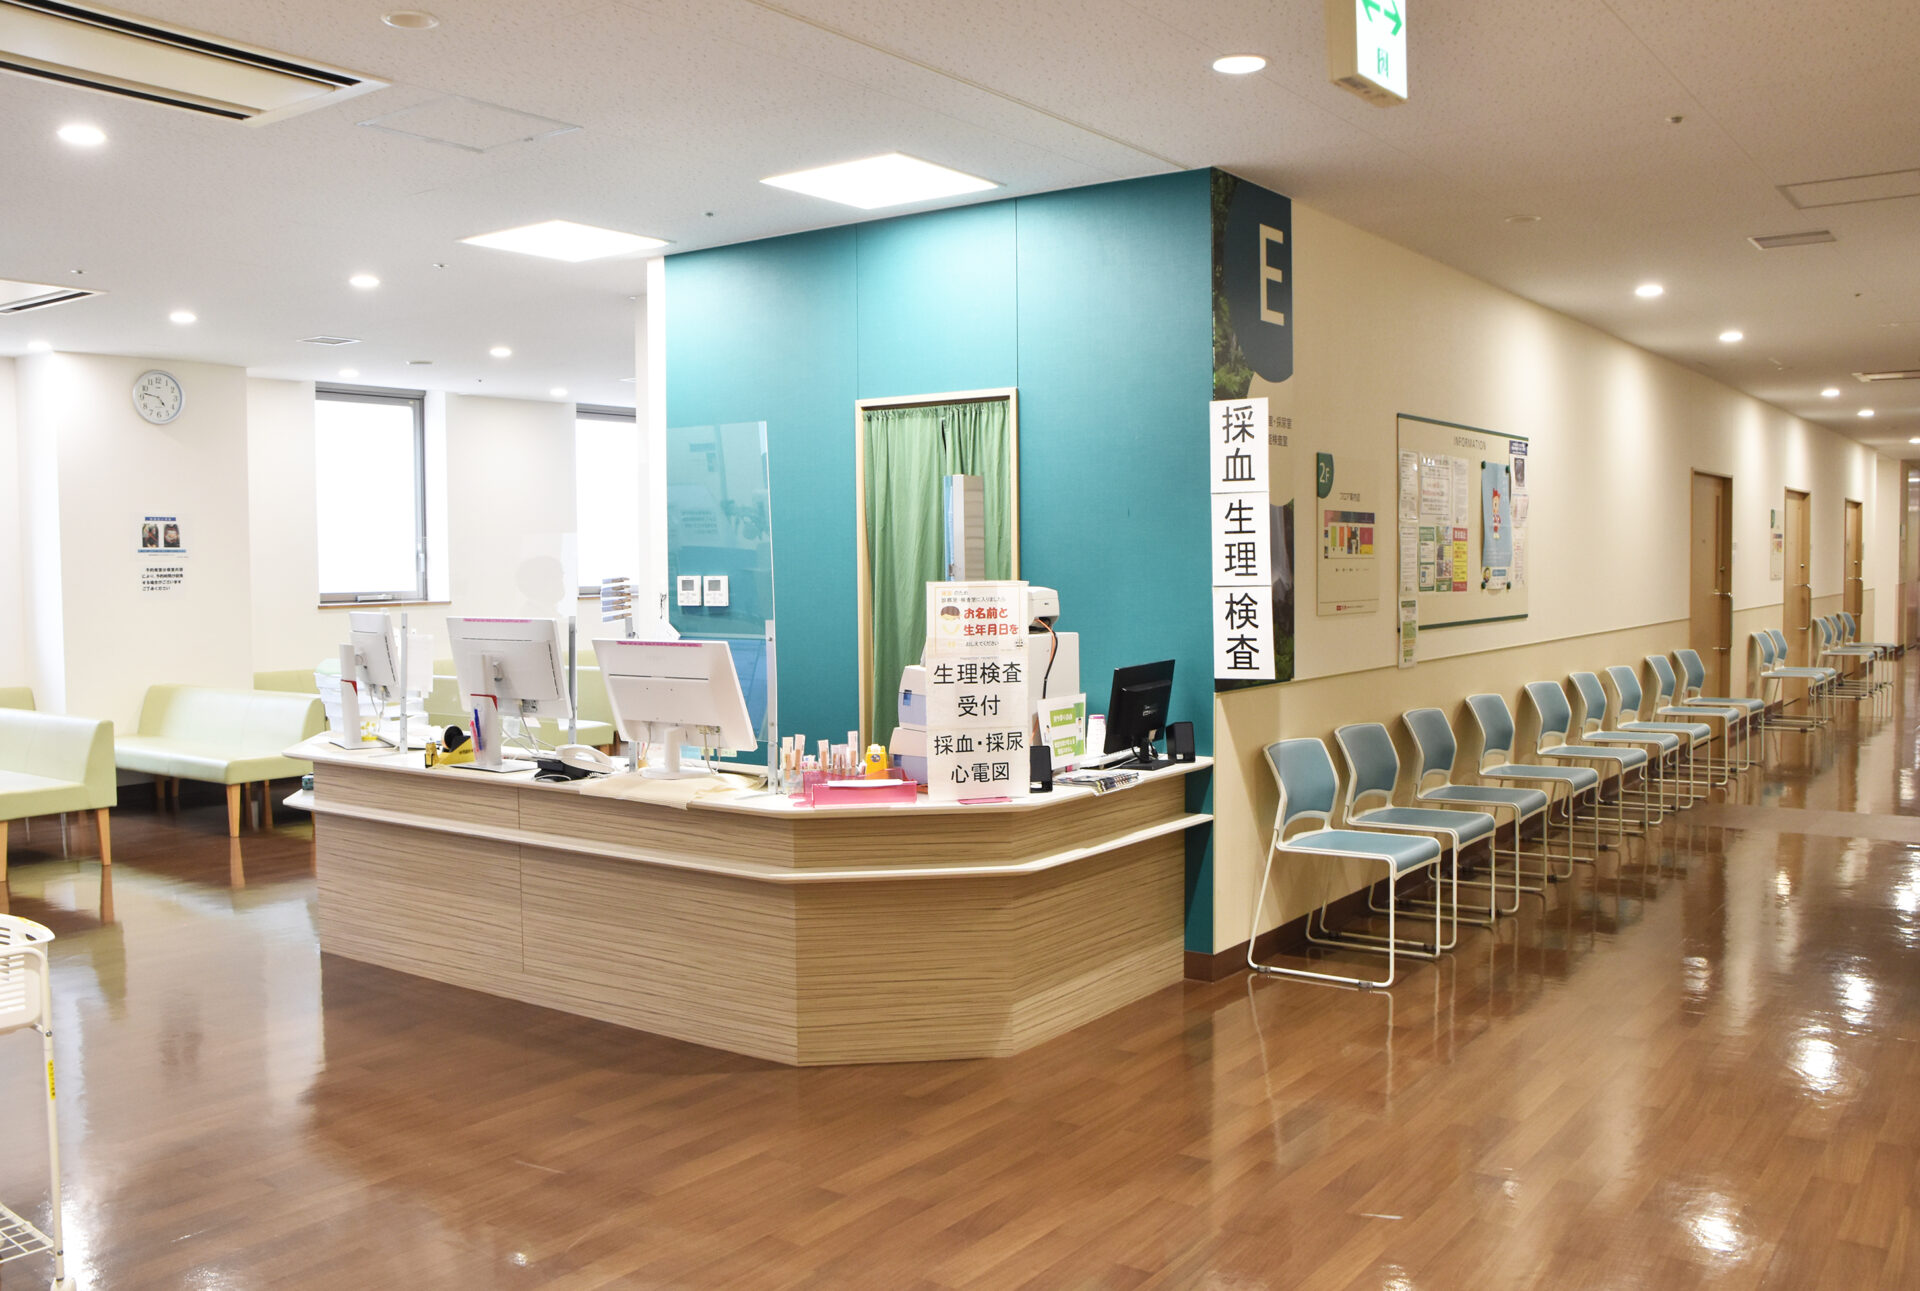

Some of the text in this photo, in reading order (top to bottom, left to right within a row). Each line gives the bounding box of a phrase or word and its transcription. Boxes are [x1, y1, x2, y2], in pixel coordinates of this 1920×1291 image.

[1259, 223, 1285, 326] E
[1454, 436, 1487, 450] INFORMATION
[1319, 461, 1331, 484] 2F
[1221, 404, 1261, 671] 採血 生理 検査
[963, 607, 1009, 620] お名前と
[963, 623, 1020, 637] 生年月日を
[933, 661, 1022, 685] 生理検査
[957, 694, 1001, 718] 受付
[933, 731, 1024, 756] 採血・採尿
[950, 761, 1010, 784] 心電図
